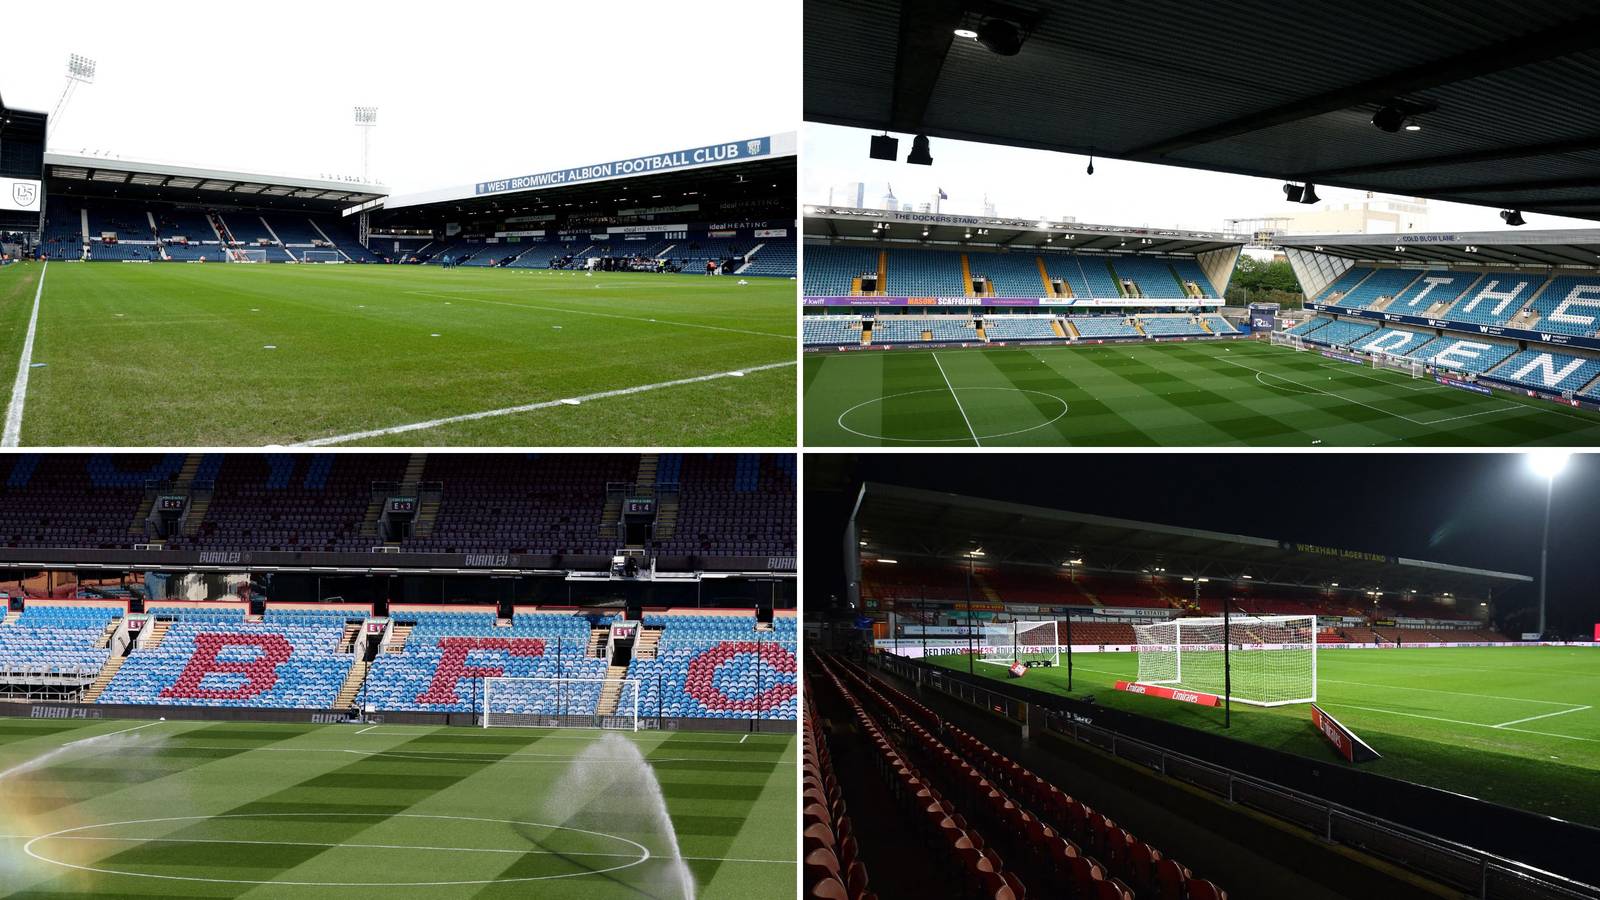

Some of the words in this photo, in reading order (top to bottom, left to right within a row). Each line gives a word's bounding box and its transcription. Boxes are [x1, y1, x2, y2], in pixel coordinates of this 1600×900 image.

[487, 180, 510, 192] WEST
[512, 171, 565, 189] BROMWICH
[568, 165, 611, 181] ALBION
[615, 152, 689, 174] FOOTBALL
[694, 144, 738, 163] CLUB
[727, 221, 768, 229] HEATING
[912, 214, 951, 223] DOCKERS
[952, 217, 978, 225] STAND
[907, 297, 937, 305] MASONS
[938, 297, 982, 305] SCAFFOLDING
[1408, 277, 1600, 326] THE
[1362, 330, 1587, 387] DEN
[199, 551, 241, 563] BURNLEY
[1296, 543, 1338, 556] WREXHAM
[1340, 549, 1363, 560] LAGER
[1364, 552, 1386, 563] STAND
[465, 554, 508, 567] BURNLEY
[924, 647, 939, 657] RED
[1125, 682, 1146, 694] Emirates
[1172, 690, 1198, 703] Emirates
[31, 705, 87, 718] BURNLEY
